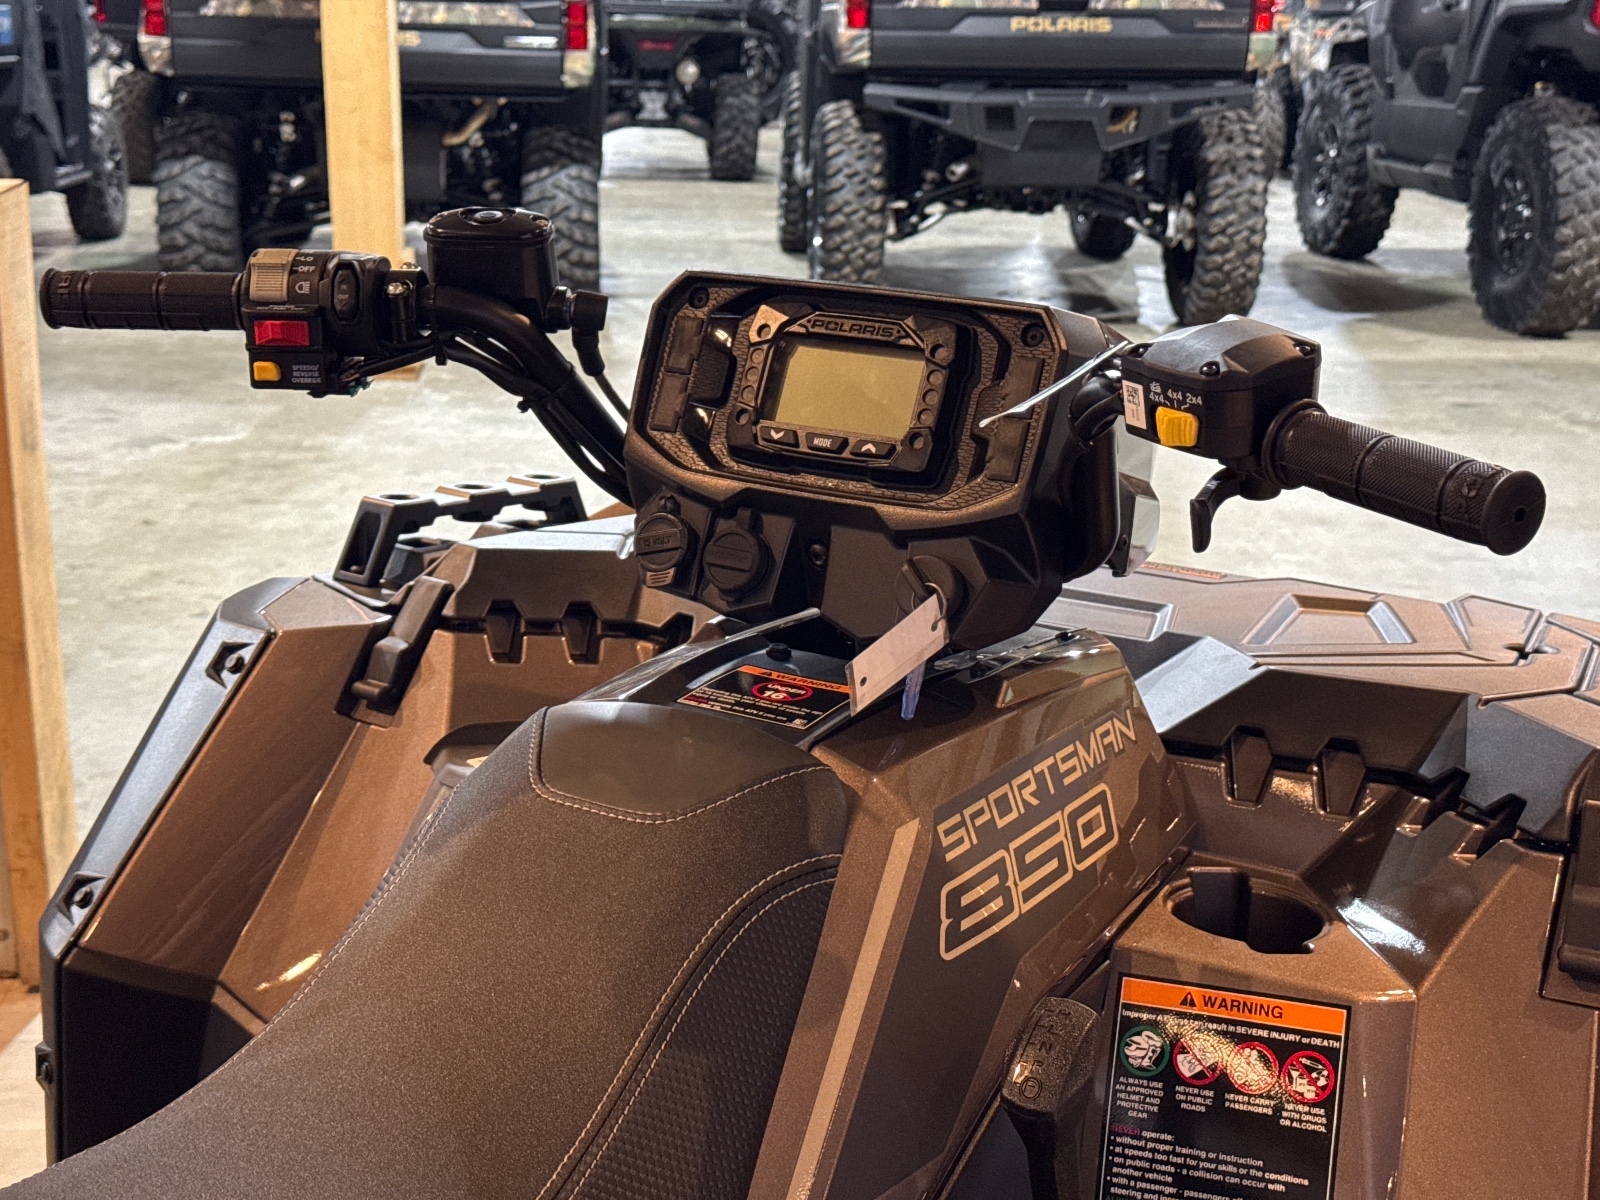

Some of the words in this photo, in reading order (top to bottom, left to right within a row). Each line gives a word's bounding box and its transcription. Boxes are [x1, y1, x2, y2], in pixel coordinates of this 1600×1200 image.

[1010, 16, 1113, 33] POLARIS
[810, 318, 895, 338] POLARIS
[1149, 391, 1164, 404] 4x4
[1167, 388, 1182, 400] 4x4
[1185, 393, 1203, 405] 2x4
[812, 437, 833, 448] MODE
[652, 535, 671, 546] VOLT
[777, 673, 842, 690] WARNING
[763, 690, 788, 700] 16
[767, 683, 807, 695] UNDER
[937, 708, 1137, 863] SPORTSMAN
[939, 782, 1119, 961] 850
[1202, 994, 1284, 1019] WARNING
[1122, 1008, 1156, 1020] Improper
[1204, 1021, 1227, 1031] result
[1236, 1025, 1269, 1037] SEVERE
[1270, 1031, 1301, 1042] INJURY
[1311, 1037, 1340, 1048] DEATH
[1119, 1076, 1148, 1086] ALWAYS
[1149, 1080, 1163, 1088] USE
[1117, 1092, 1144, 1102] HELMET
[1126, 1085, 1164, 1097] APPROVED
[1175, 1085, 1199, 1095] NEVER
[1200, 1089, 1215, 1097] USE
[1116, 1100, 1159, 1112] PROTECTIVE
[1187, 1095, 1213, 1105] PUBLIC
[1224, 1092, 1248, 1102] NEVER
[1249, 1096, 1275, 1107] CARRY
[1127, 1110, 1147, 1118] GEAR
[1181, 1102, 1206, 1112] ROADS
[1225, 1101, 1273, 1115] PASSENGERS
[1284, 1102, 1309, 1113] NEVER
[1310, 1107, 1325, 1115] USE
[1281, 1110, 1300, 1119] WITH
[1301, 1113, 1327, 1124] DRUGS
[1280, 1118, 1291, 1126] OR
[1292, 1121, 1327, 1132] ALCOHOL
[1110, 1125, 1140, 1135] NEVER
[1141, 1130, 1175, 1141] operate:
[1116, 1136, 1146, 1147] without
[1147, 1141, 1174, 1152] proper
[1175, 1145, 1206, 1159] training
[1219, 1152, 1263, 1167] instruction
[1124, 1147, 1153, 1159] speeds
[1154, 1153, 1168, 1161] too
[1169, 1154, 1184, 1164] fast
[1186, 1156, 1198, 1166] for
[1199, 1160, 1217, 1170] your
[1218, 1163, 1237, 1173] skills
[1239, 1167, 1248, 1175] or
[1249, 1168, 1263, 1177] the
[1264, 1172, 1309, 1186] conditions
[1112, 1166, 1144, 1177] another
[1144, 1172, 1173, 1183] vehicle
[1126, 1157, 1151, 1168] public
[1152, 1162, 1175, 1172] roads
[1188, 1169, 1223, 1181] collision
[1225, 1176, 1240, 1184] can
[1242, 1179, 1266, 1188] occur
[1267, 1182, 1286, 1192] with
[1112, 1176, 1128, 1185] with
[1136, 1181, 1178, 1194] passenger
[1110, 1186, 1141, 1199] steering
[1143, 1191, 1158, 1200] and
